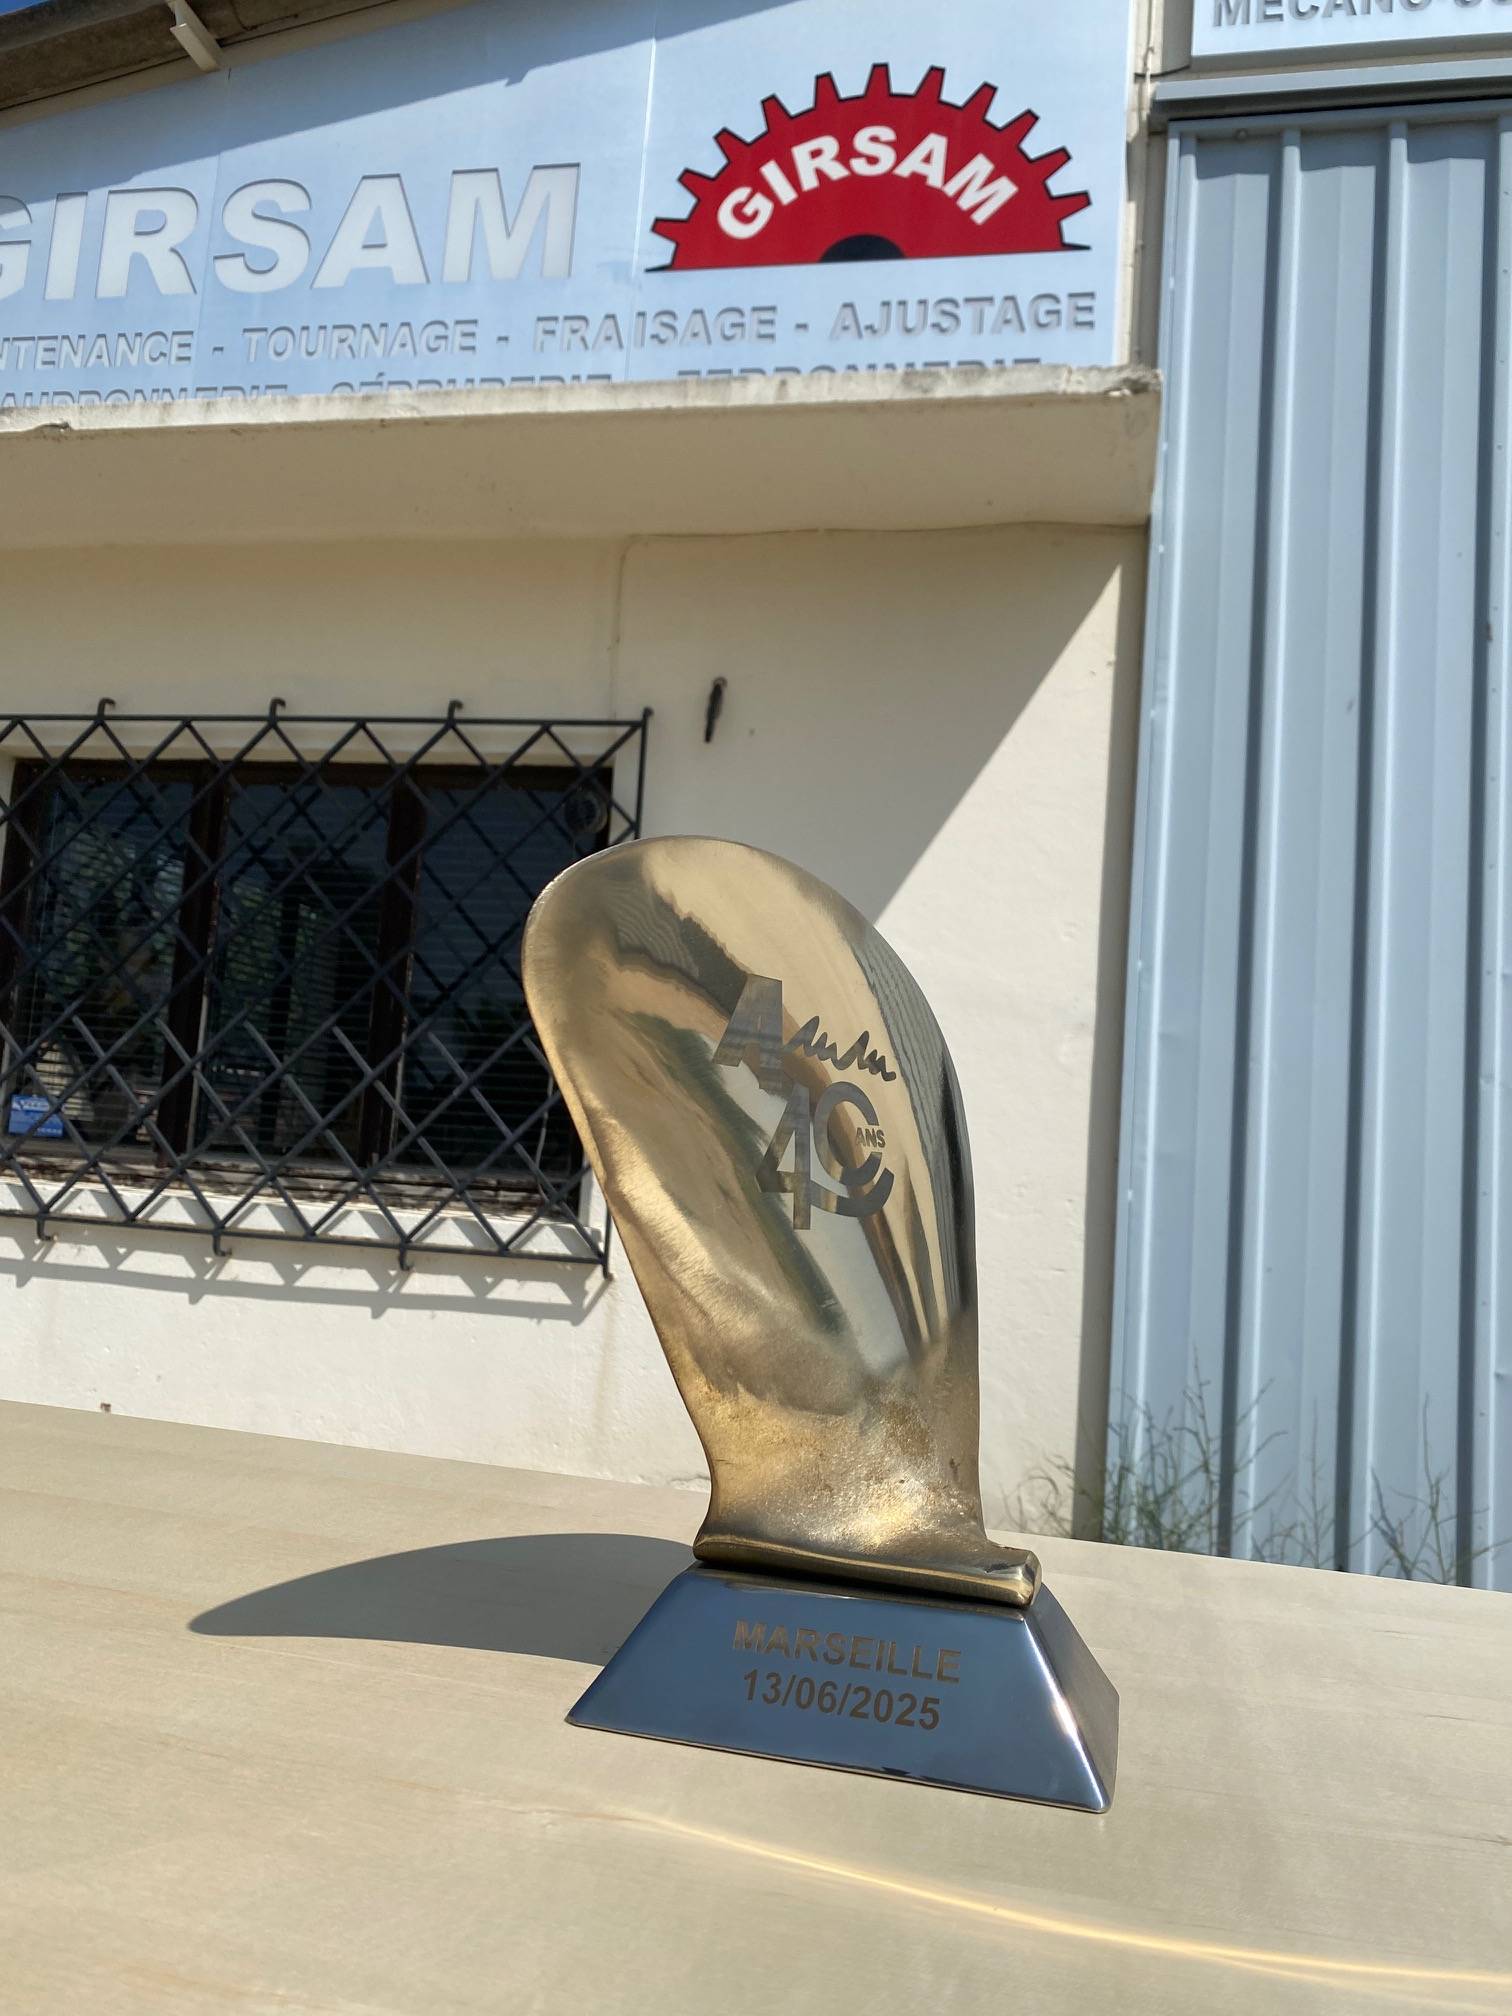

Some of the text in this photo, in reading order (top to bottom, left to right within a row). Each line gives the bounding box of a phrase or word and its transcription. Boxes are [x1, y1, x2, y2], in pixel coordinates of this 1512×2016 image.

[717, 125, 1018, 240] GIRSAM
[242, 319, 478, 363] TOURNAGE
[533, 306, 778, 352] FRAISAGE
[830, 292, 1096, 340] AJUSTAGE
[855, 1126, 886, 1149] ANS
[733, 1619, 962, 1684] MARSEILLE
[744, 1668, 941, 1731] 13/06/2025
